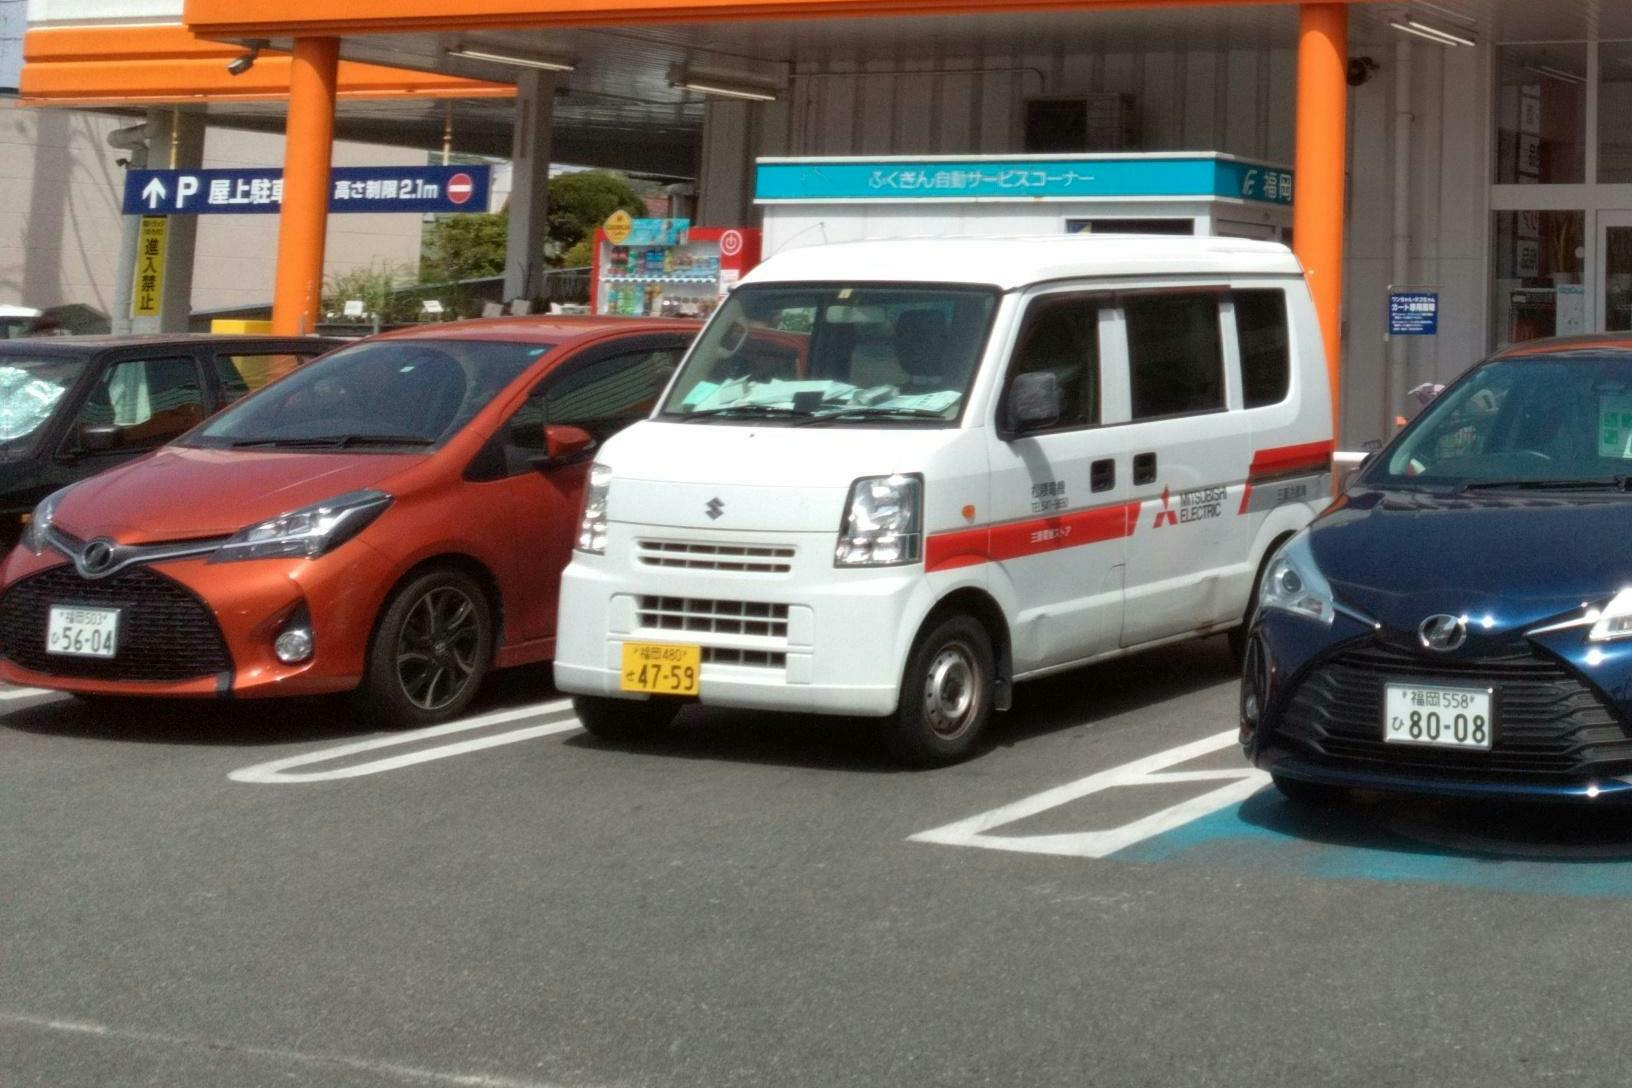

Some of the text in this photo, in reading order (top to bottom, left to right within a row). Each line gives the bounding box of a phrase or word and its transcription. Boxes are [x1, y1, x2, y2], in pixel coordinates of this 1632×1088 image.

[176, 176, 198, 209] P
[868, 169, 1095, 189] ふくぎん自動サービスコーナー
[140, 238, 160, 310] 進入禁止
[1179, 486, 1227, 507] MITSUBISHI
[1179, 502, 1222, 523] ELECTRIC
[62, 626, 113, 653] 56-04
[638, 664, 695, 691] 47-59
[1409, 710, 1486, 744] 80-08
